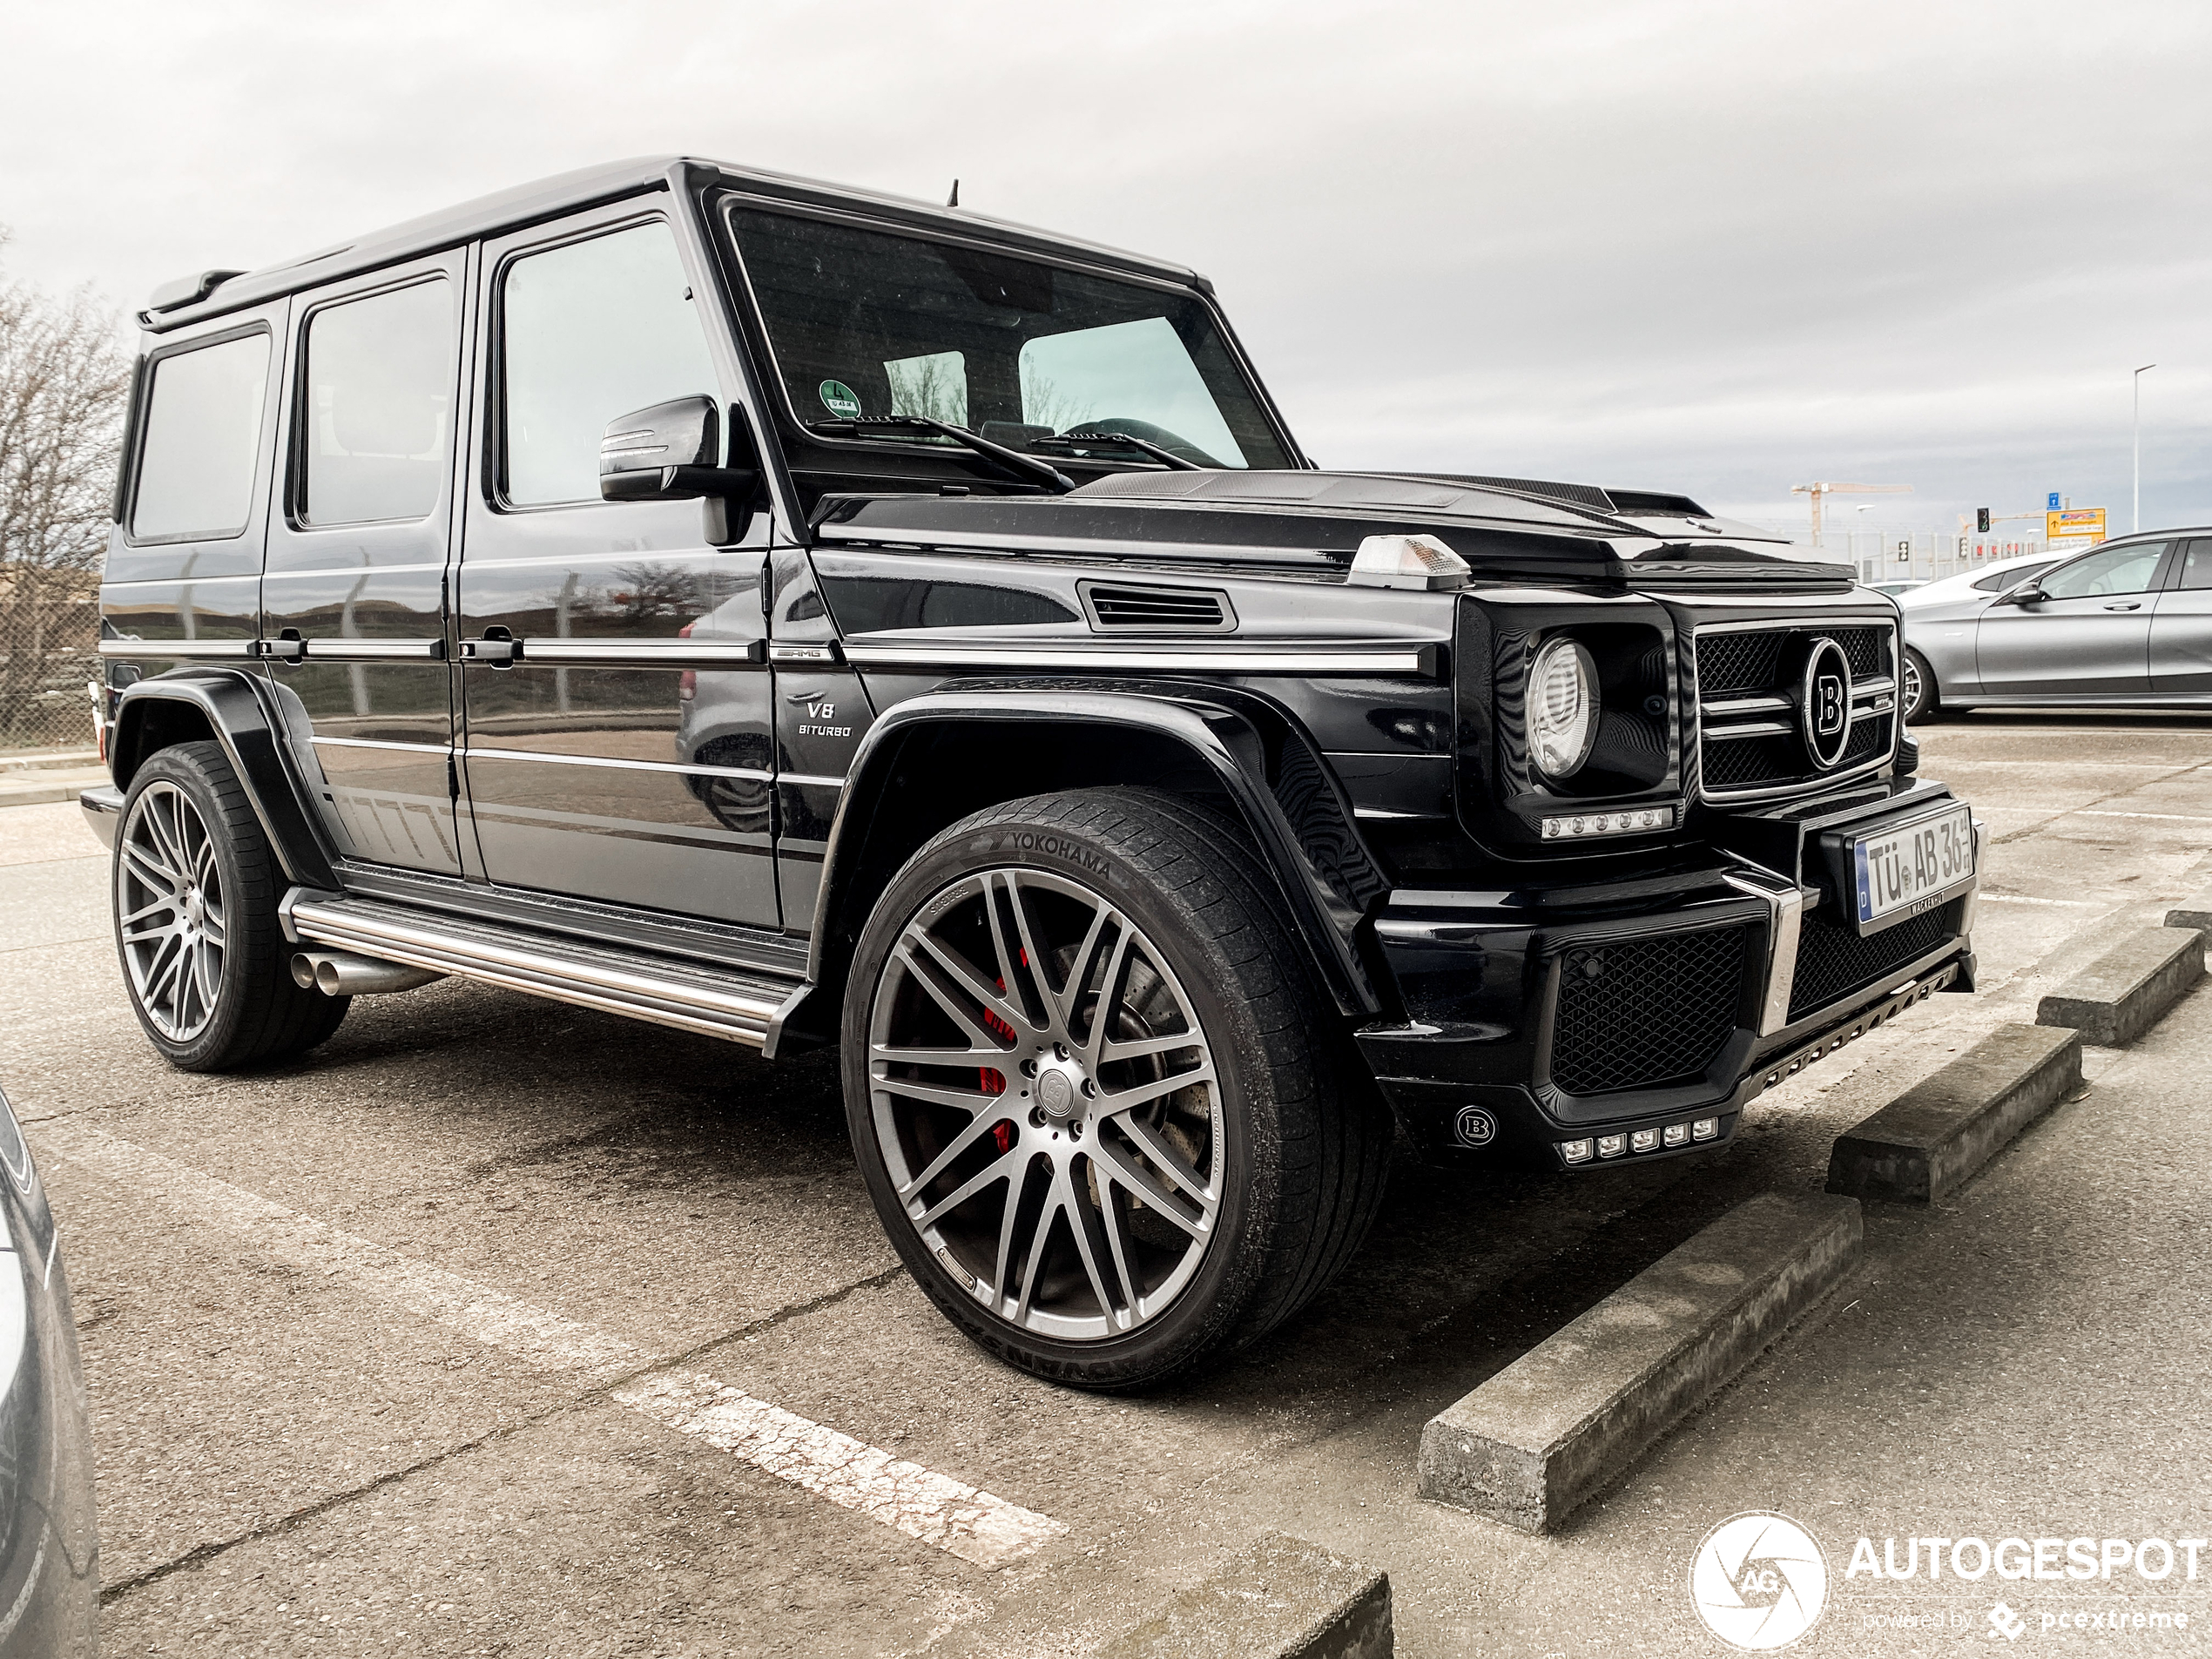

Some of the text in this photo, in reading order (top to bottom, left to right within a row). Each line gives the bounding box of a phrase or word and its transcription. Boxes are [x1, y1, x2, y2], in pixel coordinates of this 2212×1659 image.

[833, 383, 844, 400] 4
[807, 702, 836, 719] V8
[1818, 675, 1843, 736] B
[799, 725, 853, 737] BITURBO
[1012, 832, 1111, 880] YOKOHAMA
[1870, 842, 1901, 907] TÜ
[1915, 829, 1938, 892] AB
[1940, 819, 1962, 878] 36
[1860, 892, 1867, 908] D
[1466, 1116, 1489, 1138] B
